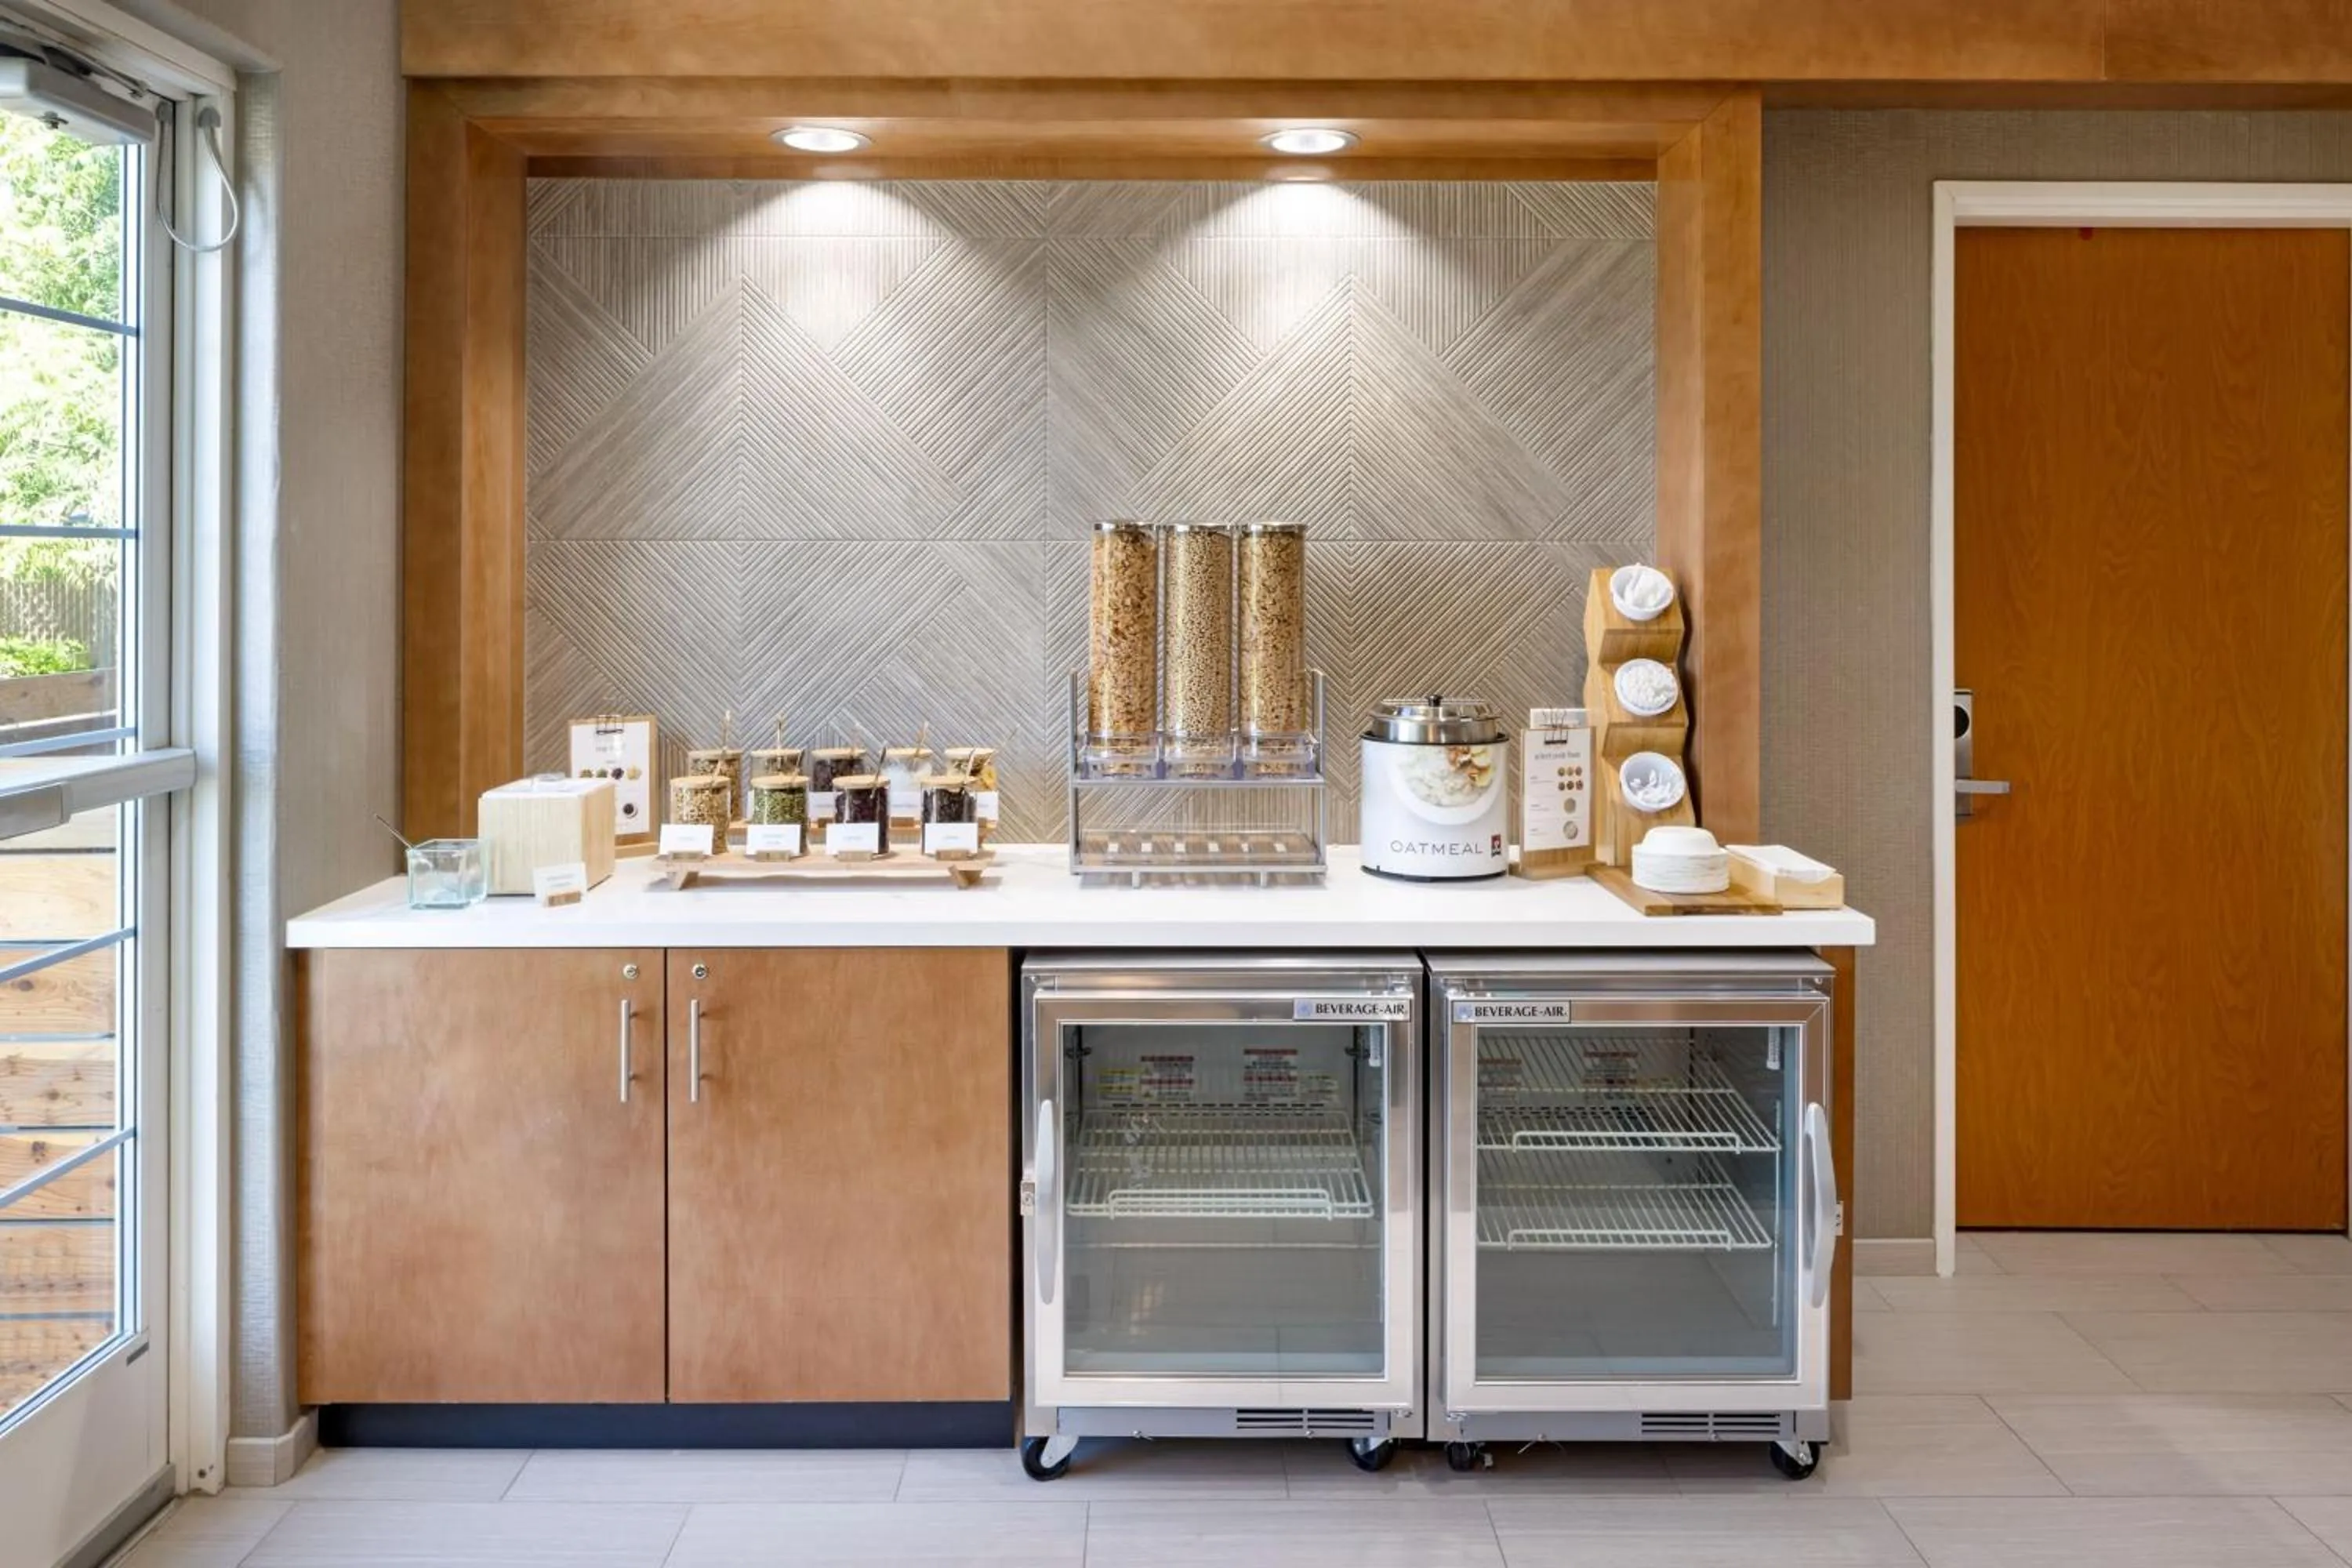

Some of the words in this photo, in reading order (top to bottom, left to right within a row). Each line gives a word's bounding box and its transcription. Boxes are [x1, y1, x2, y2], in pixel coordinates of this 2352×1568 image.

[1390, 840, 1483, 855] OATMEAL
[1315, 1003, 1405, 1014] BEVERAGE-AIR
[1475, 1006, 1564, 1018] BEVERAGE-AIR
